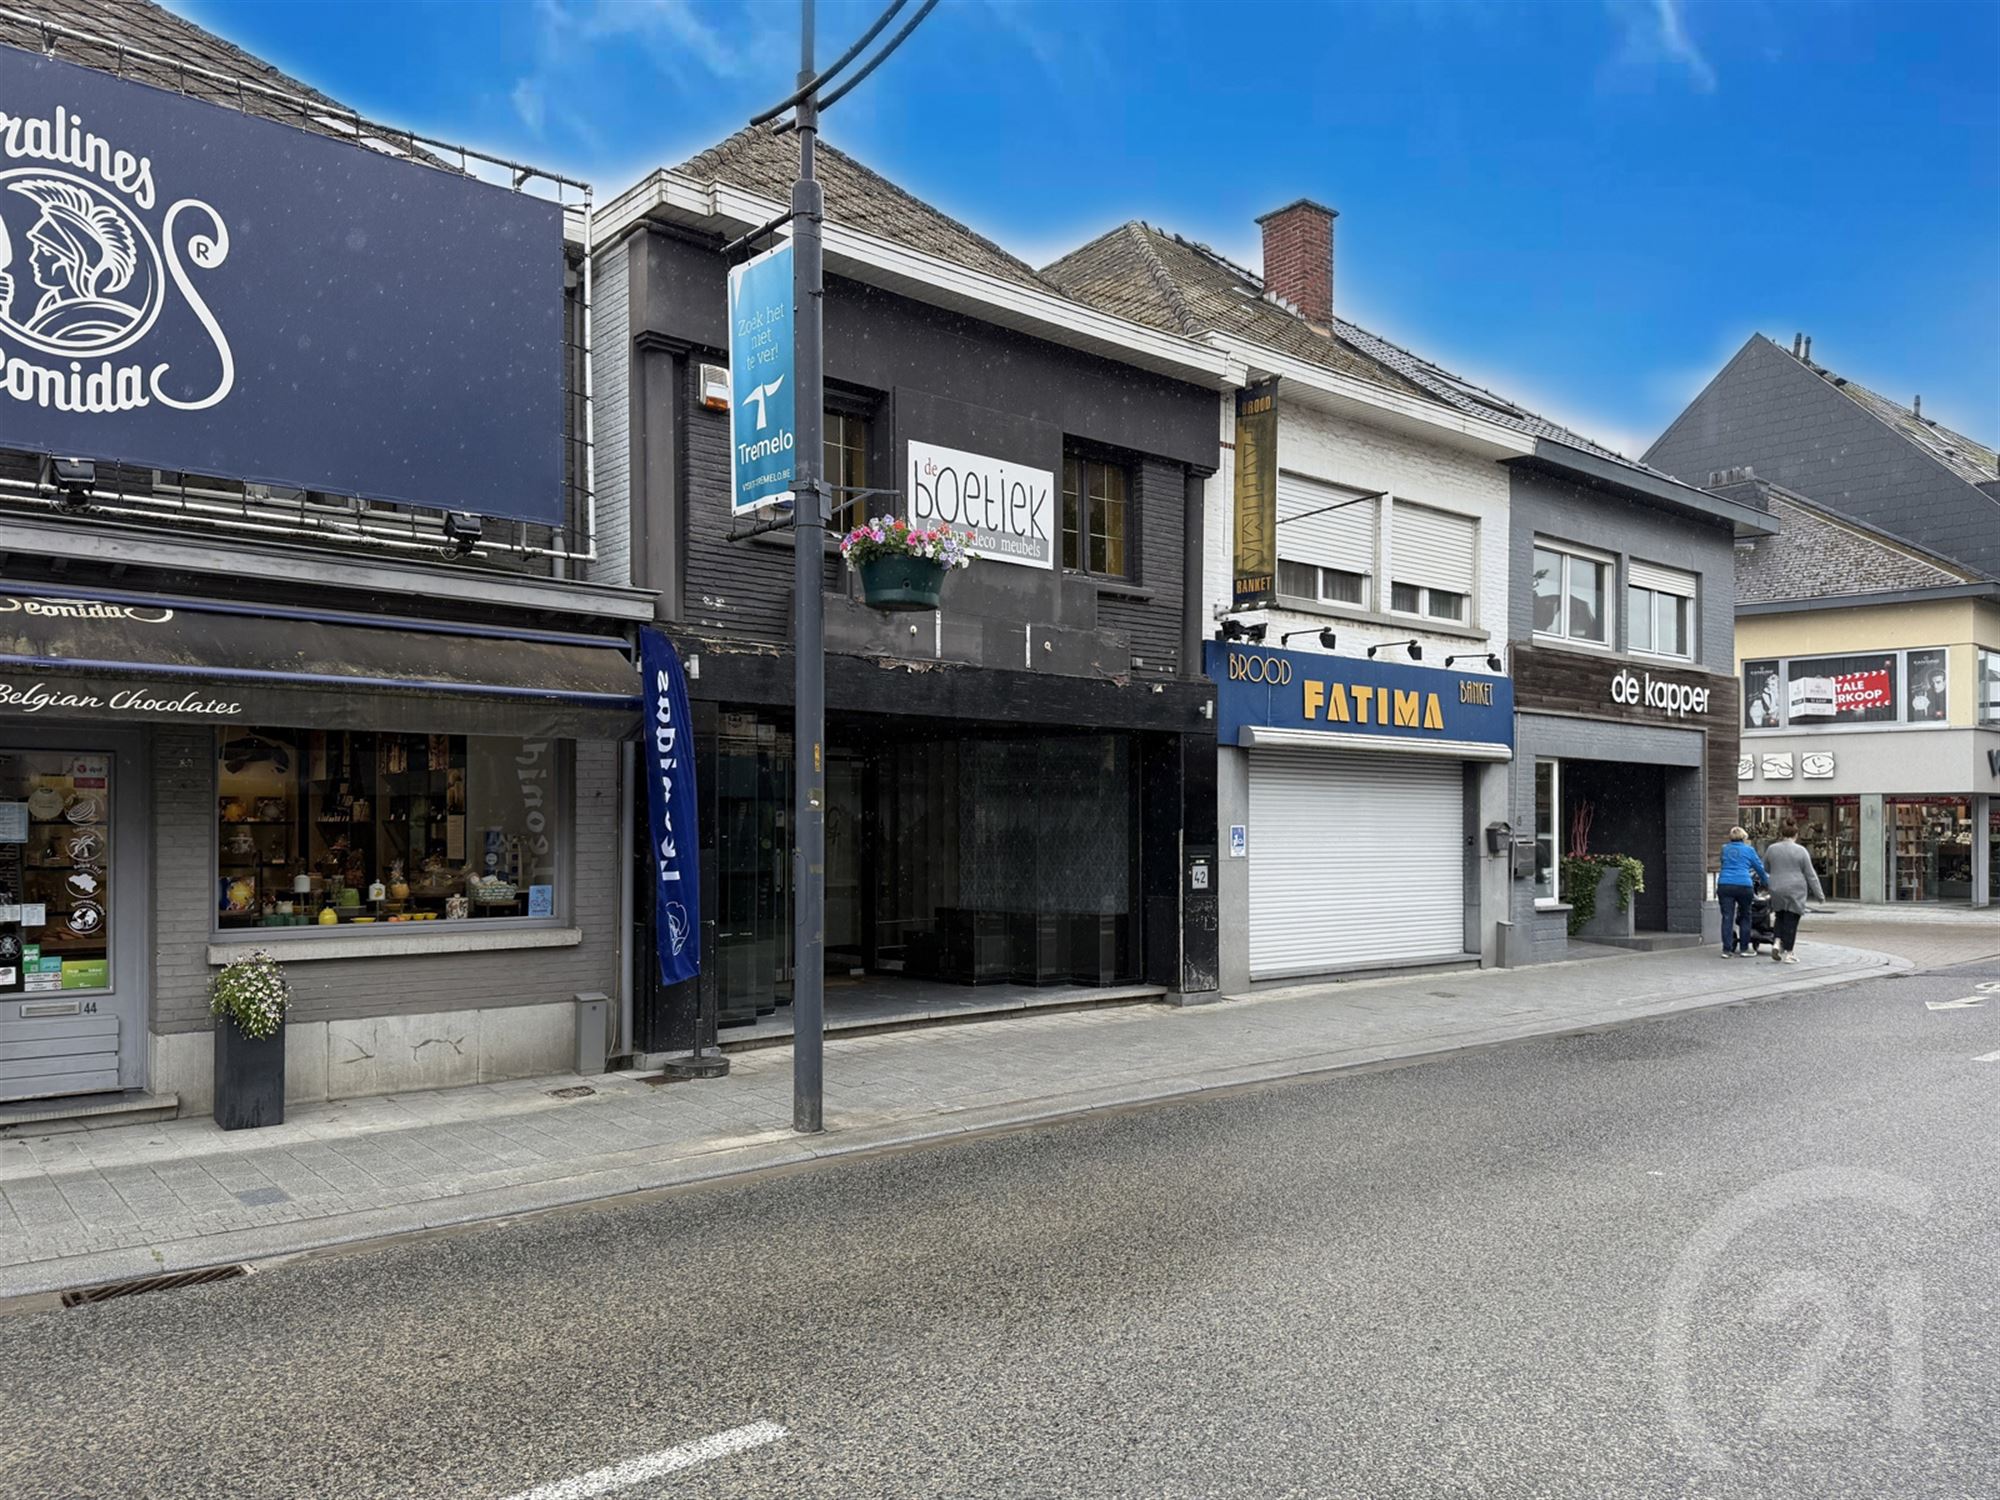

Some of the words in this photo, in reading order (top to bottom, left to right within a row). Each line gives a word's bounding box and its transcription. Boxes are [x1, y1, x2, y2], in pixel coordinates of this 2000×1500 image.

[737, 310, 764, 337] Zoek
[766, 303, 785, 324] het
[751, 328, 772, 350] niet
[746, 355, 756, 371] te
[757, 343, 779, 365] ver!
[738, 429, 794, 466] Tremelo
[924, 457, 938, 477] de
[972, 527, 996, 550] deco
[1001, 536, 1041, 558] meubels
[1236, 576, 1272, 595] BANKET
[1228, 652, 1292, 685] BROOD
[0, 683, 104, 713] Belgian
[109, 688, 242, 715] Chocolates
[1459, 680, 1493, 706] BANKET
[1611, 669, 1640, 705] de
[1645, 672, 1710, 718] kapper
[1836, 681, 1865, 693] TALE
[1303, 679, 1445, 730] FATIMA
[1194, 871, 1206, 884] 42
[84, 1002, 97, 1014] 44
